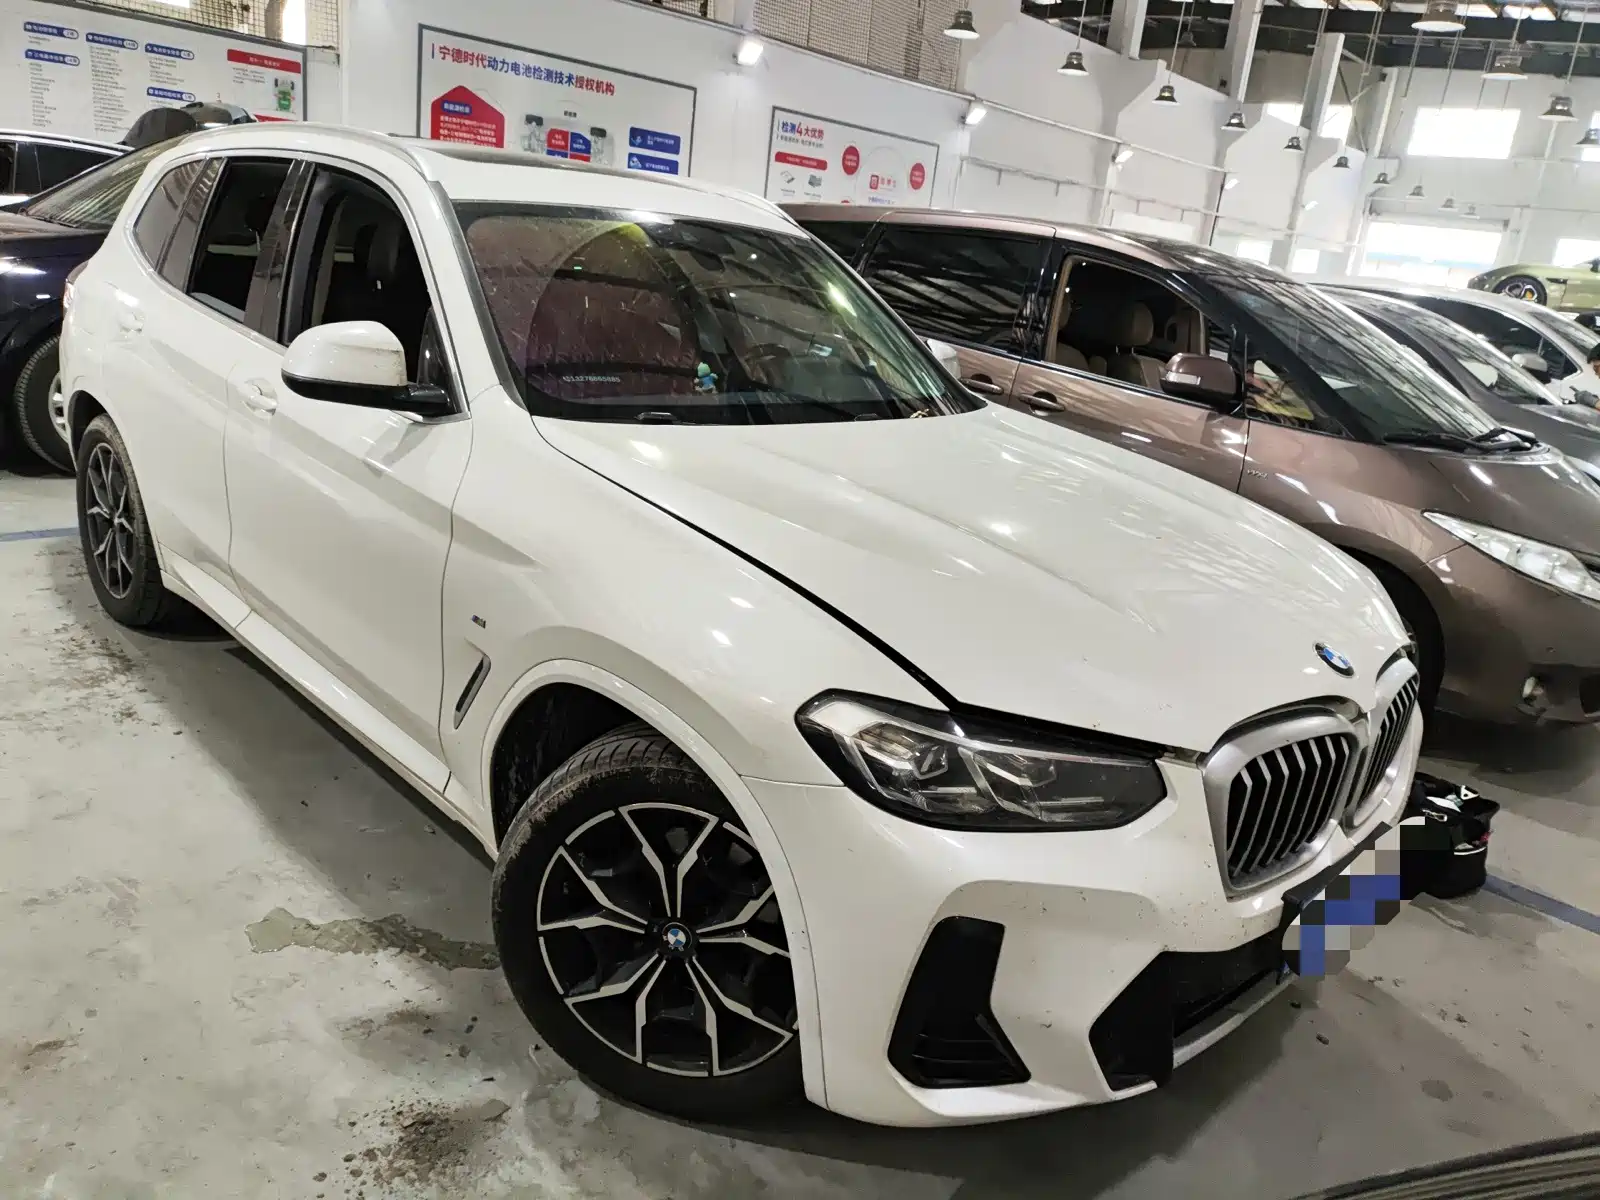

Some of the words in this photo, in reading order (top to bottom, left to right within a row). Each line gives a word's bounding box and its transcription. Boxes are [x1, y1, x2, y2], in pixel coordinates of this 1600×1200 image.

[439, 45, 615, 96] 宁德时代动力电池检测技术授权机构
[782, 120, 825, 140] 检测4大优势
